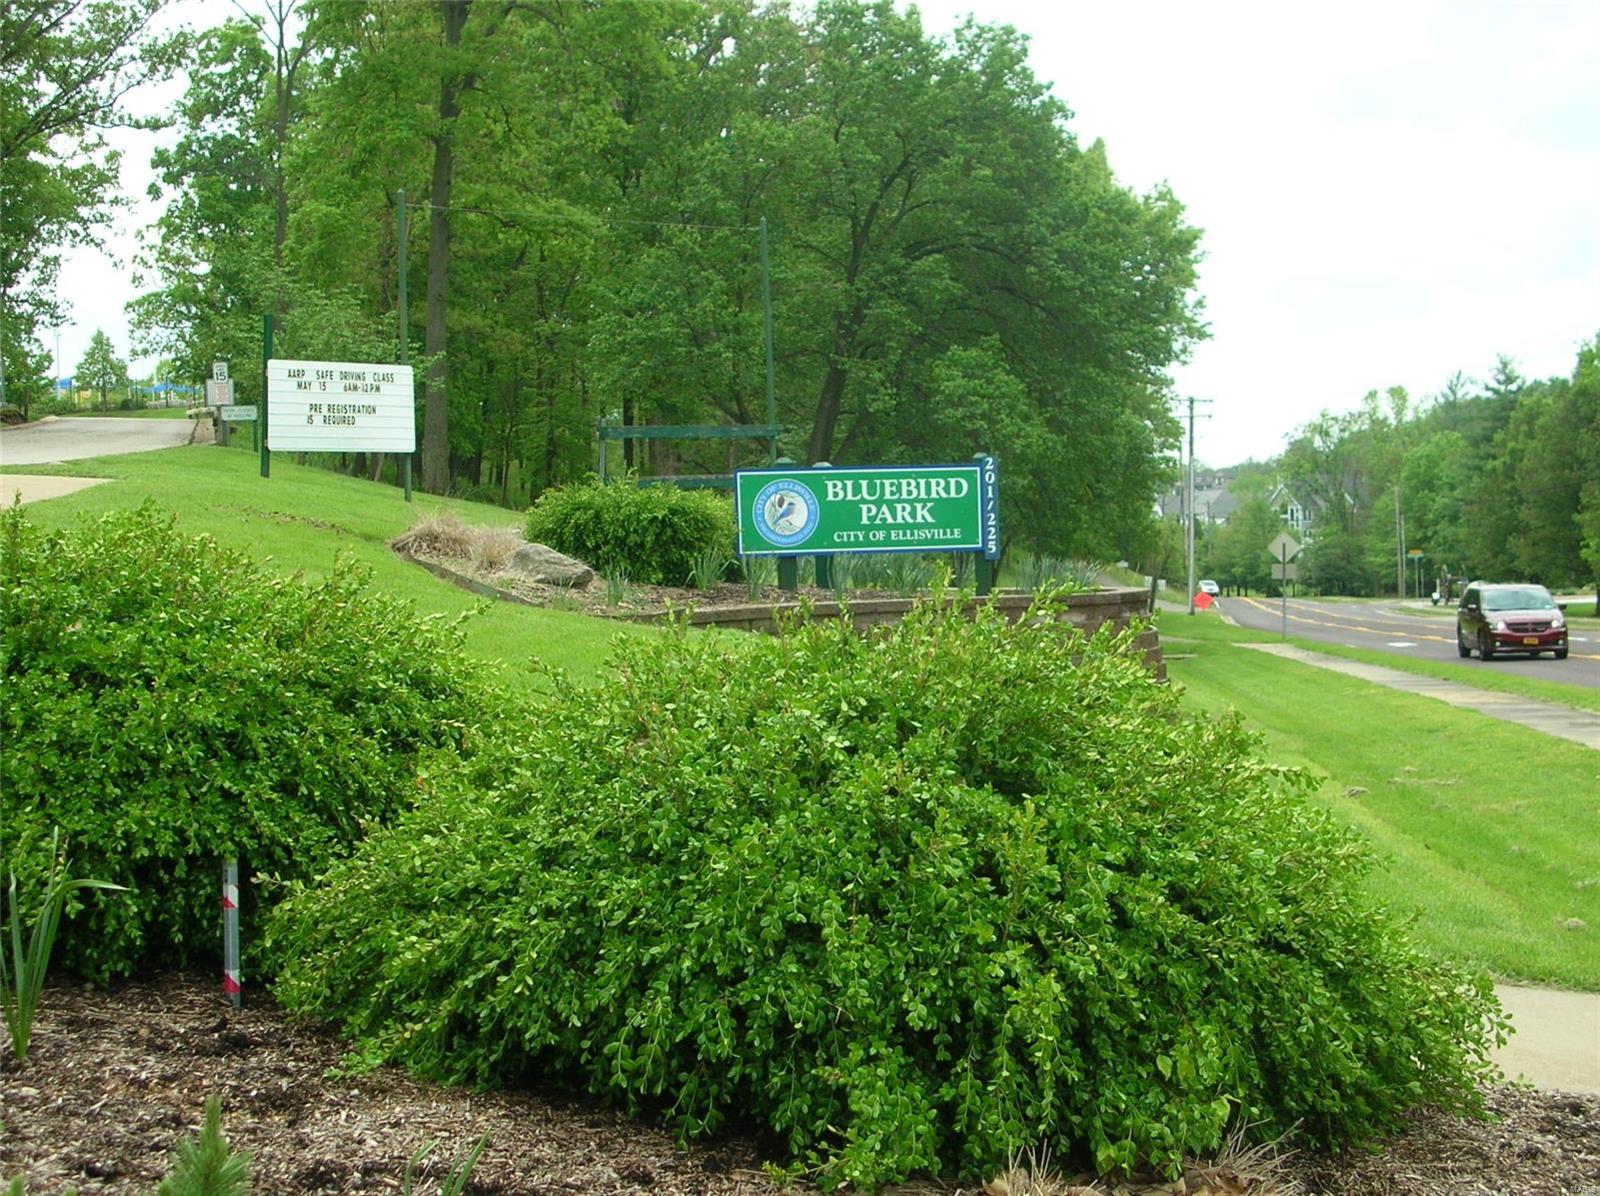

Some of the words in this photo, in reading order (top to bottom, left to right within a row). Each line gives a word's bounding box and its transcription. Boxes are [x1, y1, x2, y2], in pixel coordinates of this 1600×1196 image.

[215, 371, 227, 381] 15
[288, 369, 306, 379] AARP
[316, 370, 334, 380] SAFE
[339, 371, 366, 382] DRIVING
[372, 372, 395, 383] CLASS
[296, 381, 312, 391] MAY
[319, 382, 327, 391] 15
[309, 403, 322, 413] PRE
[327, 404, 377, 415] REGISTRATION
[307, 415, 314, 425] IS
[323, 415, 356, 426] REQUIRED
[824, 477, 969, 501] BLUEBIRD
[985, 457, 997, 554] 201/225
[859, 502, 936, 525] PARK
[833, 530, 865, 542] CITY
[869, 529, 887, 541] OF
[890, 527, 962, 541] ELLISVILLE
